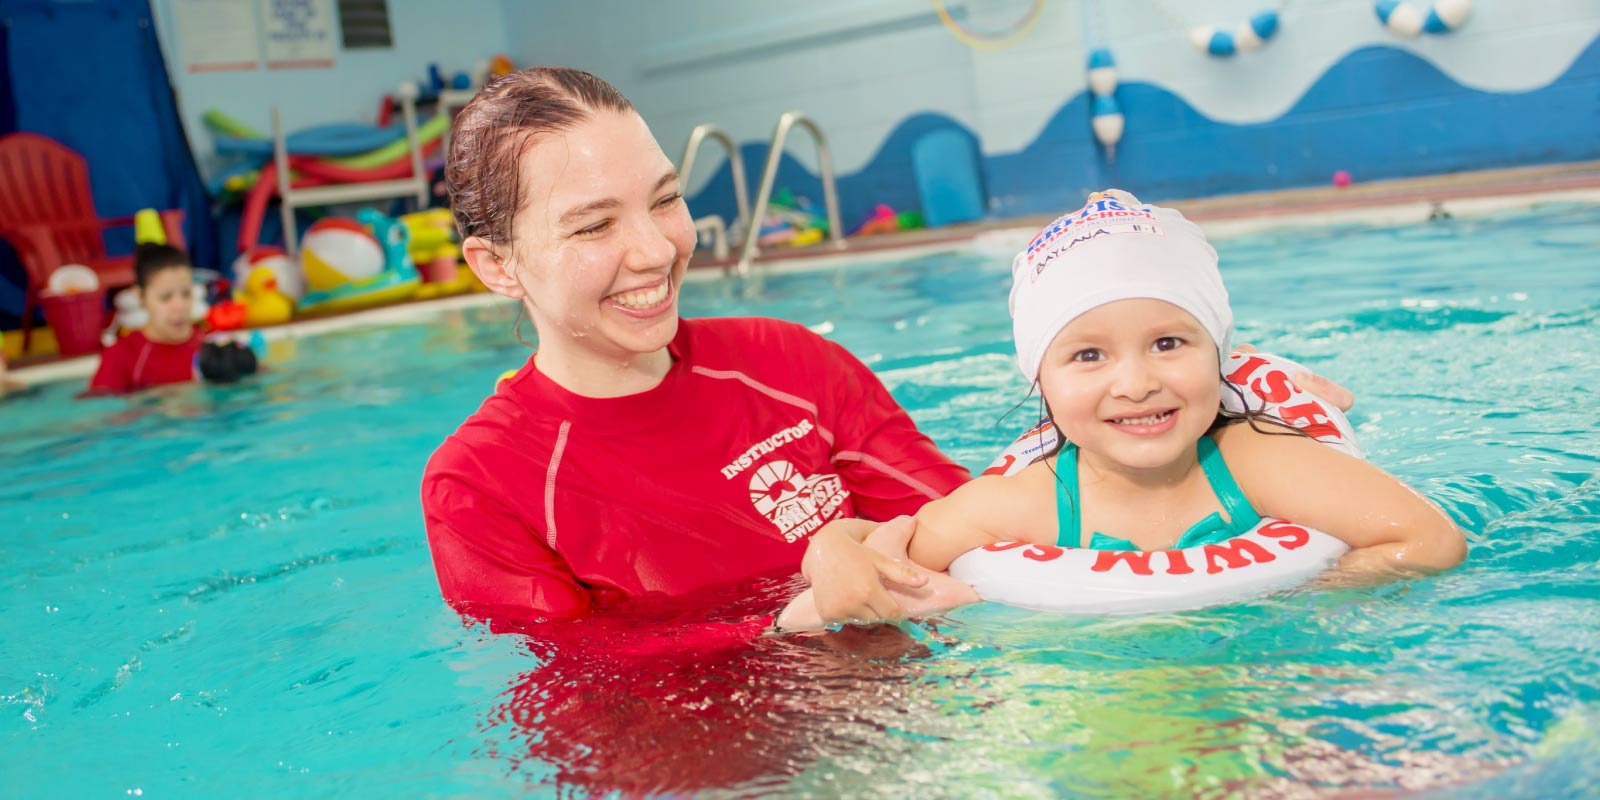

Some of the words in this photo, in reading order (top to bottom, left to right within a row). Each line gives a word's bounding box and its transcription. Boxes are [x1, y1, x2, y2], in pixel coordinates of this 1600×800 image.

[1074, 211, 1157, 226] SCHOOL
[784, 514, 824, 544] SWIM
[1090, 519, 1311, 576] SWIM
